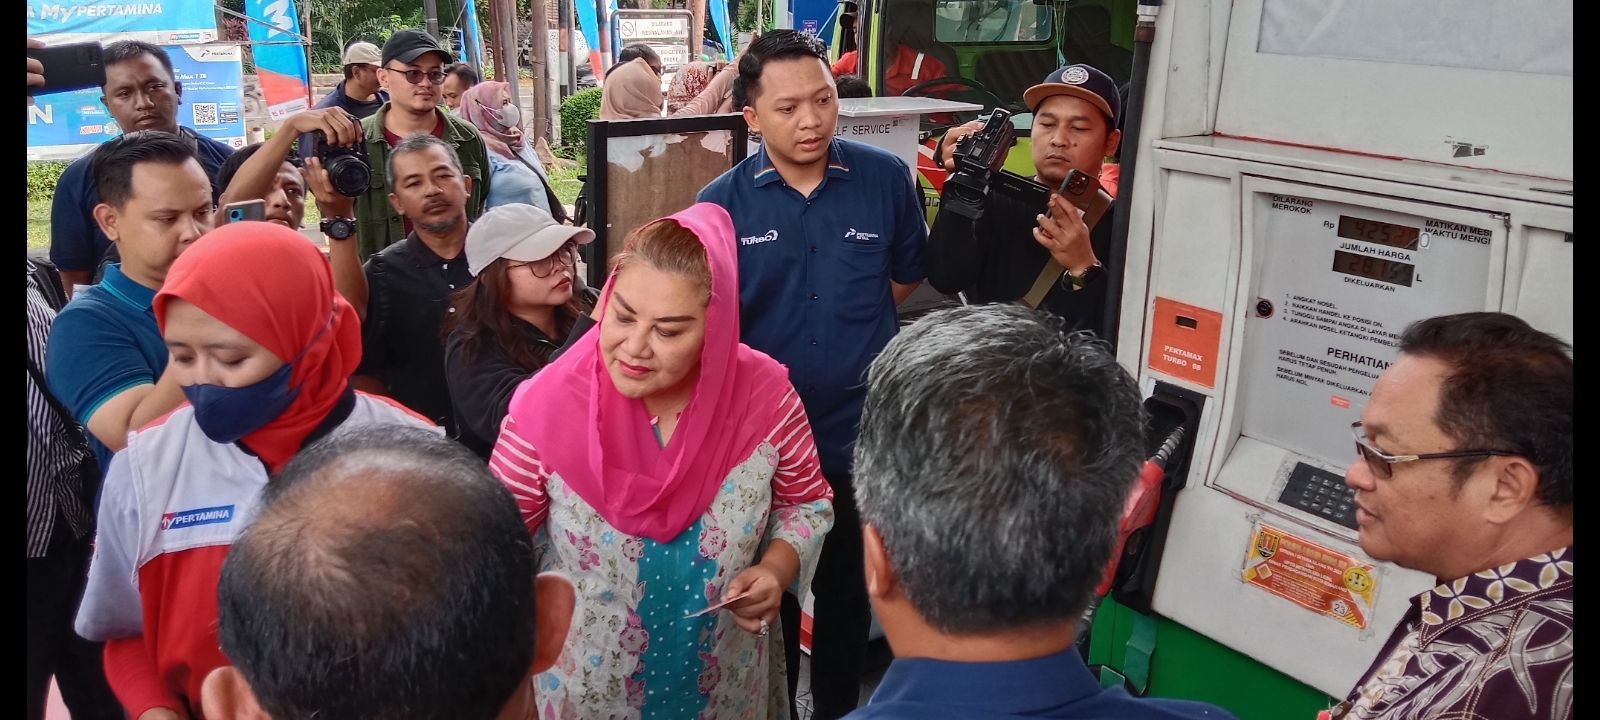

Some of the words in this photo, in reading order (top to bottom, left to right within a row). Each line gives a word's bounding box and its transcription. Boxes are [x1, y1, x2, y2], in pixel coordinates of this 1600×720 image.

[41, 3, 162, 24] MyPERTAMINA
[852, 123, 891, 136] SERVICE
[1273, 195, 1314, 208] DILARANG
[1271, 203, 1312, 215] MEROKOK
[1323, 220, 1335, 230] Rp
[1425, 219, 1467, 233] MATIKAN
[741, 234, 774, 246] TURBO
[1424, 228, 1458, 240] WAKTU
[1339, 242, 1376, 255] JUMLAH
[1378, 248, 1411, 262] HARGA
[1344, 276, 1396, 293] DIKELUARKAN
[1415, 273, 1423, 283] L
[1293, 295, 1316, 305] ANGKAT
[1292, 302, 1317, 313] NAIKKAN
[1319, 309, 1341, 319] HANDEL
[1353, 316, 1372, 326] POSISI
[1290, 317, 1318, 329] ARAHKAN
[1319, 325, 1338, 334] NOSEL
[1339, 330, 1369, 341] KETANGKI
[1291, 309, 1315, 320] TUNGGU
[1316, 315, 1338, 326] SAMPAI
[1338, 321, 1360, 331] ANGKA
[1368, 328, 1388, 338] LAYAR
[1164, 344, 1203, 362] PERTAMAX
[1162, 354, 1187, 367] TURBO
[1278, 355, 1298, 365] HARUS
[1299, 360, 1316, 369] TETAP
[1279, 349, 1305, 361] SEBELUM
[1306, 356, 1319, 364] DAN
[1319, 359, 1347, 372] SESUDAH
[1276, 373, 1295, 382] HARUS
[1277, 366, 1303, 378] SEBELUM
[1304, 374, 1325, 384] MINYAK
[1326, 380, 1368, 396] DIKELUARKAN
[161, 509, 230, 530] MyPERTAMINA
[1333, 602, 1345, 615] 23
